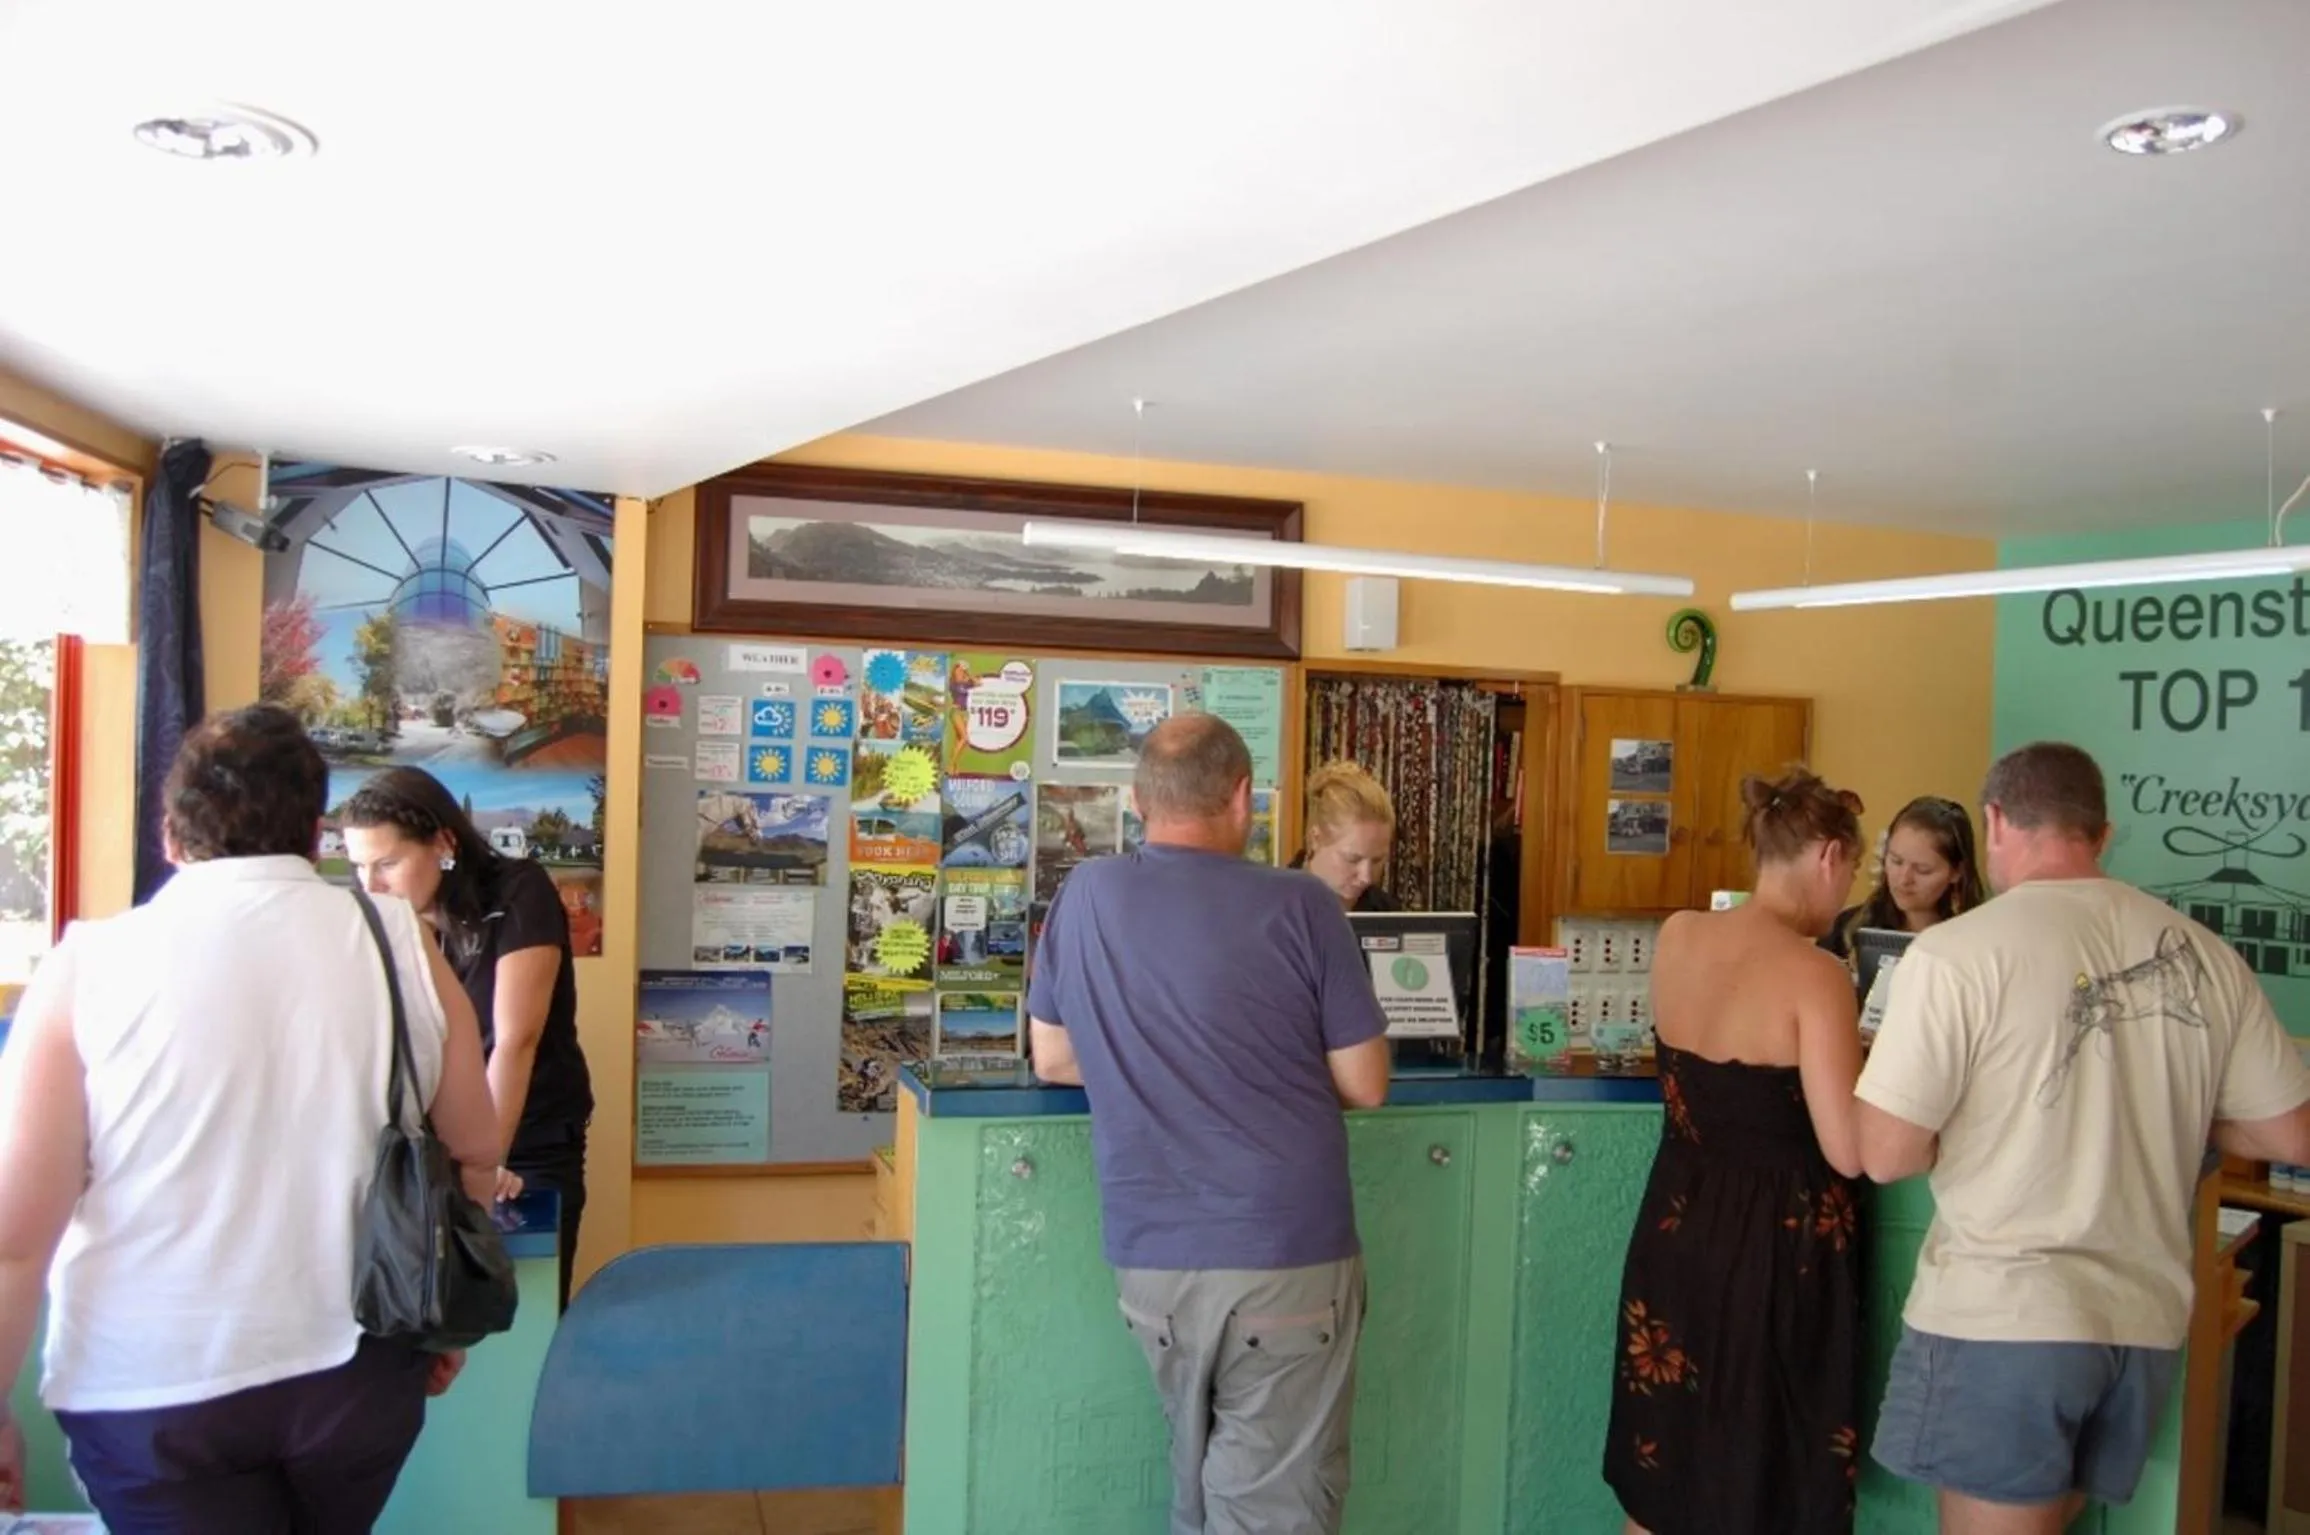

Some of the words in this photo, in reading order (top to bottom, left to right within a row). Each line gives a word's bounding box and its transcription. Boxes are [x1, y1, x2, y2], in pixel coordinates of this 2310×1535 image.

[2042, 577, 2310, 646] Queenst
[741, 652, 799, 666] WEATHER
[2119, 668, 2257, 732] TOP
[1527, 1021, 1555, 1045] $5
